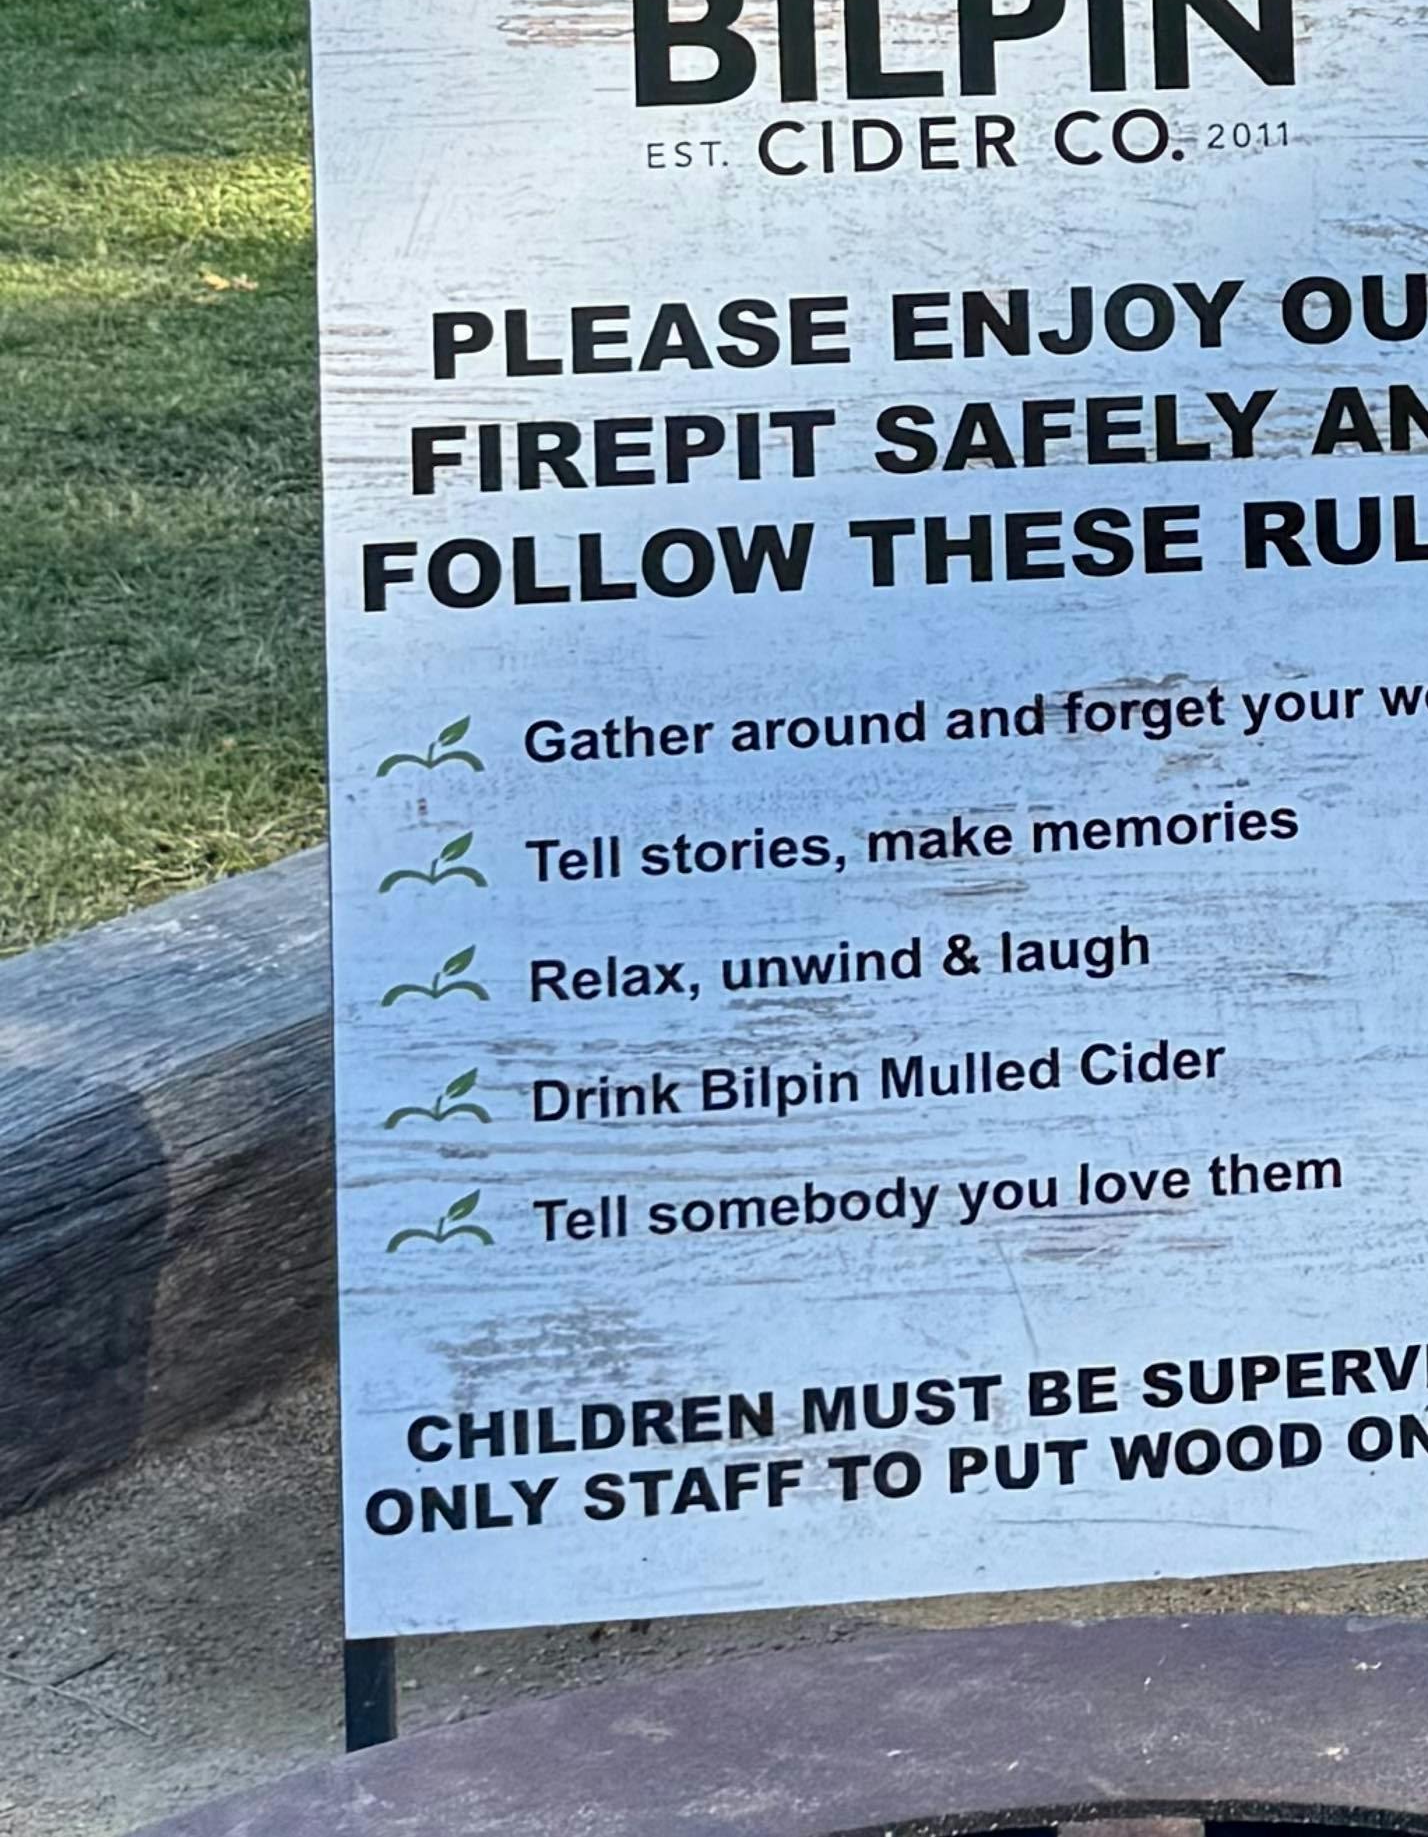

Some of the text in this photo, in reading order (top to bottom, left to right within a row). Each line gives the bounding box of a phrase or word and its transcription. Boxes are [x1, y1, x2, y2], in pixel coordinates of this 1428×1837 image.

[647, 108, 1288, 176] EST. CIDER CO. 2011
[432, 296, 851, 380] PLEASE
[892, 280, 1245, 361] ENJOY
[411, 409, 836, 496] FIREPIT
[874, 389, 1278, 474] SAFELY
[363, 522, 815, 613] FOLLOW
[849, 504, 1203, 587] THESE
[524, 715, 714, 763] Gather
[731, 700, 926, 752] around
[946, 693, 1045, 740] and
[1060, 686, 1225, 741] forget
[1241, 688, 1364, 736] your
[525, 800, 1299, 882] Tell stories, make memories
[531, 925, 1149, 1003] Relax, unwind & laugh
[533, 1039, 1226, 1122] Drink Bilpin Mulled Cider
[532, 1153, 1342, 1242] Tell somebody you love them
[407, 1391, 774, 1463] CHILDREN
[803, 1374, 1002, 1435] MUST
[1028, 1366, 1118, 1417] BE
[365, 1477, 559, 1536] ONLY
[584, 1459, 803, 1521] STAFF
[827, 1451, 922, 1501] TO
[949, 1439, 1088, 1494] PUT
[1110, 1422, 1322, 1481] WOOD
